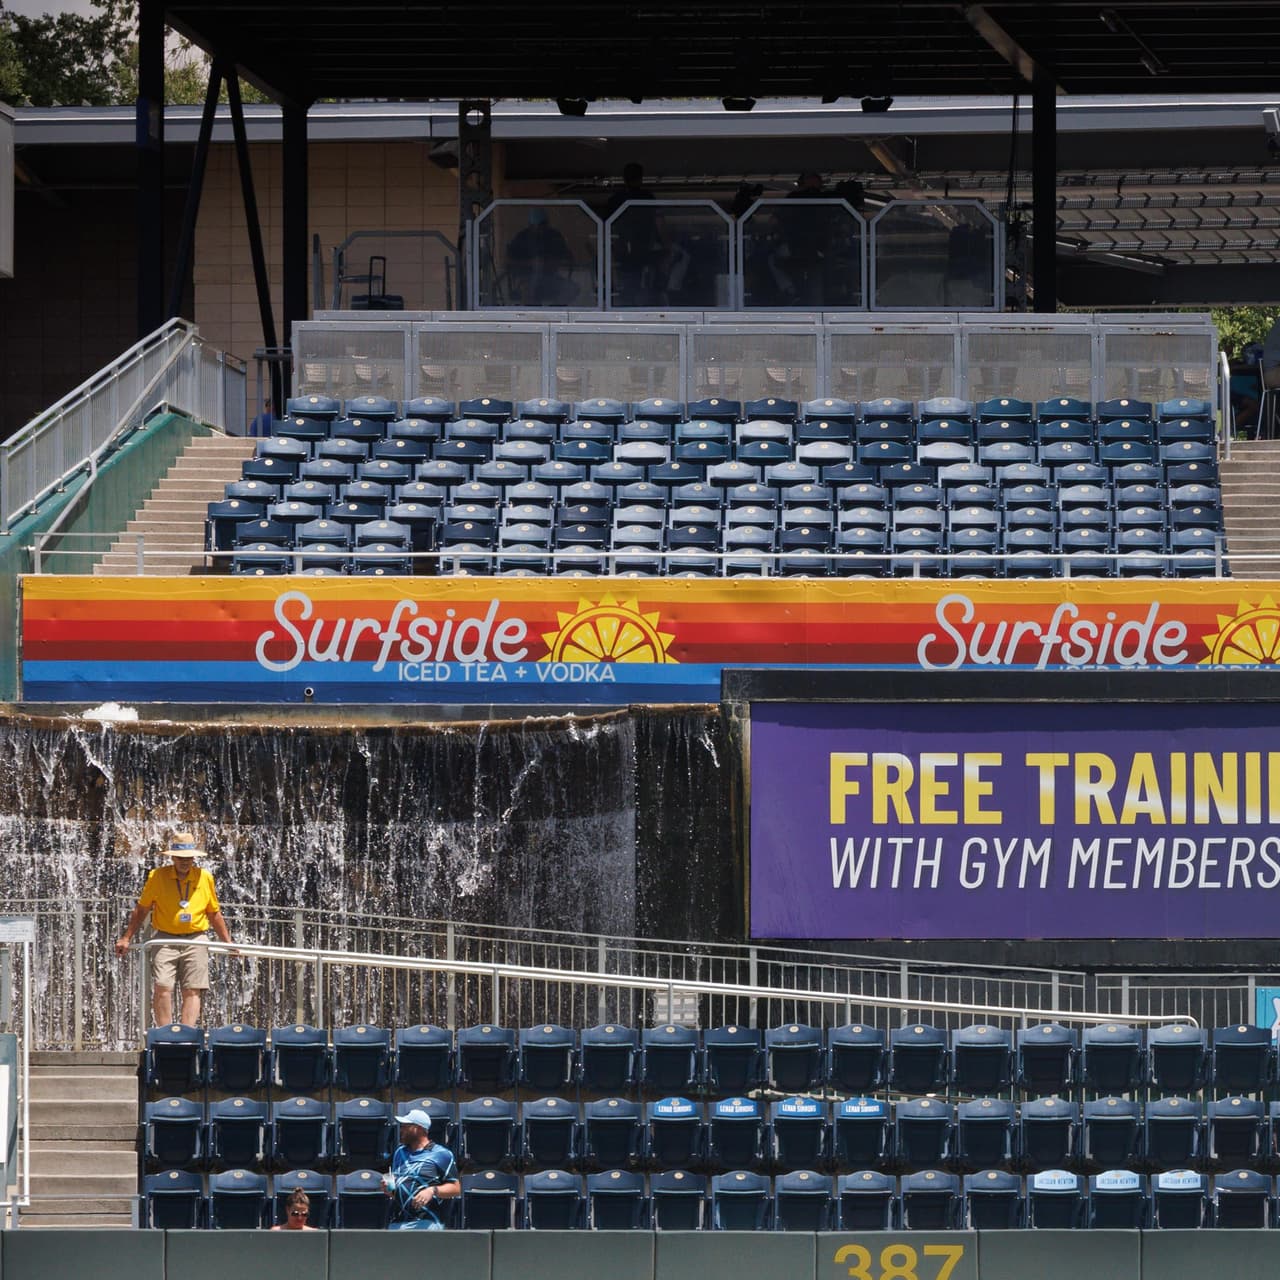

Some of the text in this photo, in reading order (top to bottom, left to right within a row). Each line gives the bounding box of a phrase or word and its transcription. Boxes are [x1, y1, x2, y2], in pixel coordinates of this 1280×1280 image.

[255, 590, 528, 672] Surfside
[917, 593, 1188, 670] Surfside
[398, 662, 450, 682] ICED
[460, 662, 507, 682] TEA
[535, 662, 616, 682] VODKA
[829, 752, 1002, 824] FREE
[830, 837, 943, 888] WITH
[959, 837, 1053, 888] GYM
